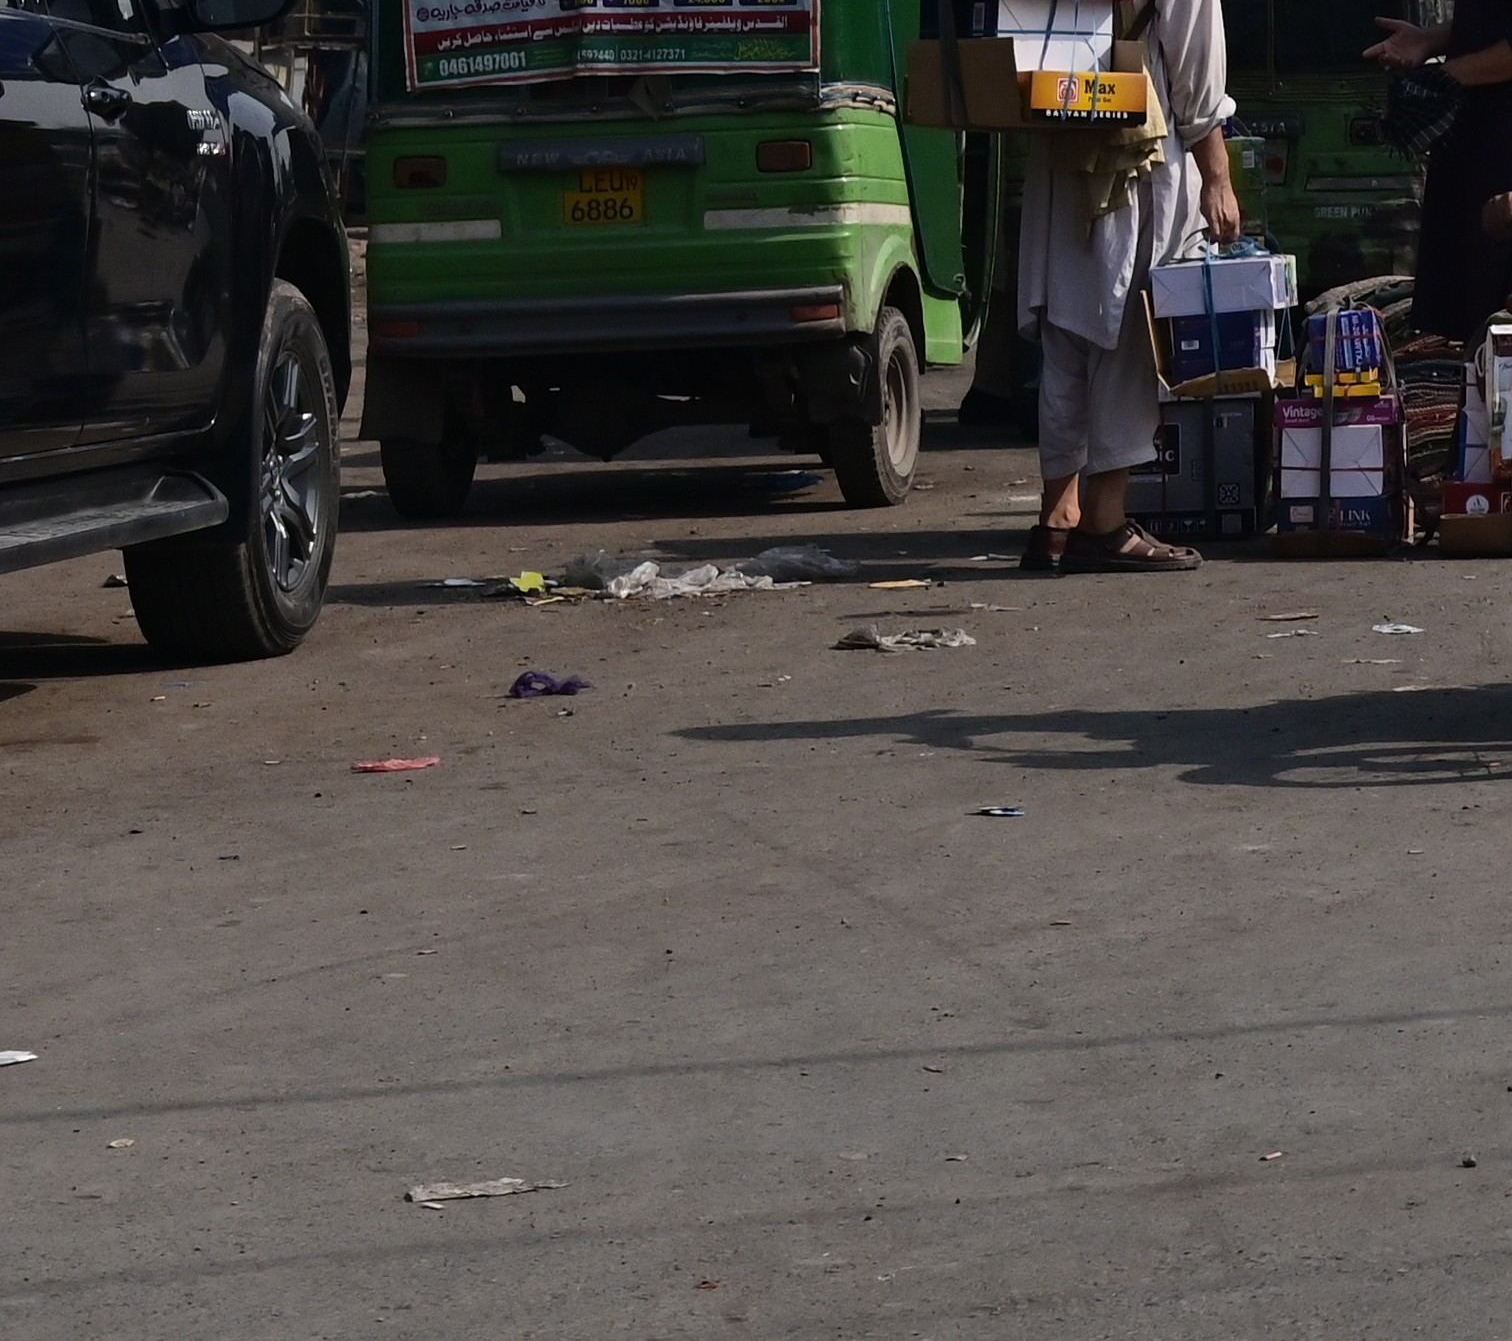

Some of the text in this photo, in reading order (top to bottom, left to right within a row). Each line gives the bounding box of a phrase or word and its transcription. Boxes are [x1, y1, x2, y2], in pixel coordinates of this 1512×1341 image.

[1084, 79, 1116, 95] Max
[516, 149, 688, 165] NEW ASIA
[571, 197, 634, 222] 6886
